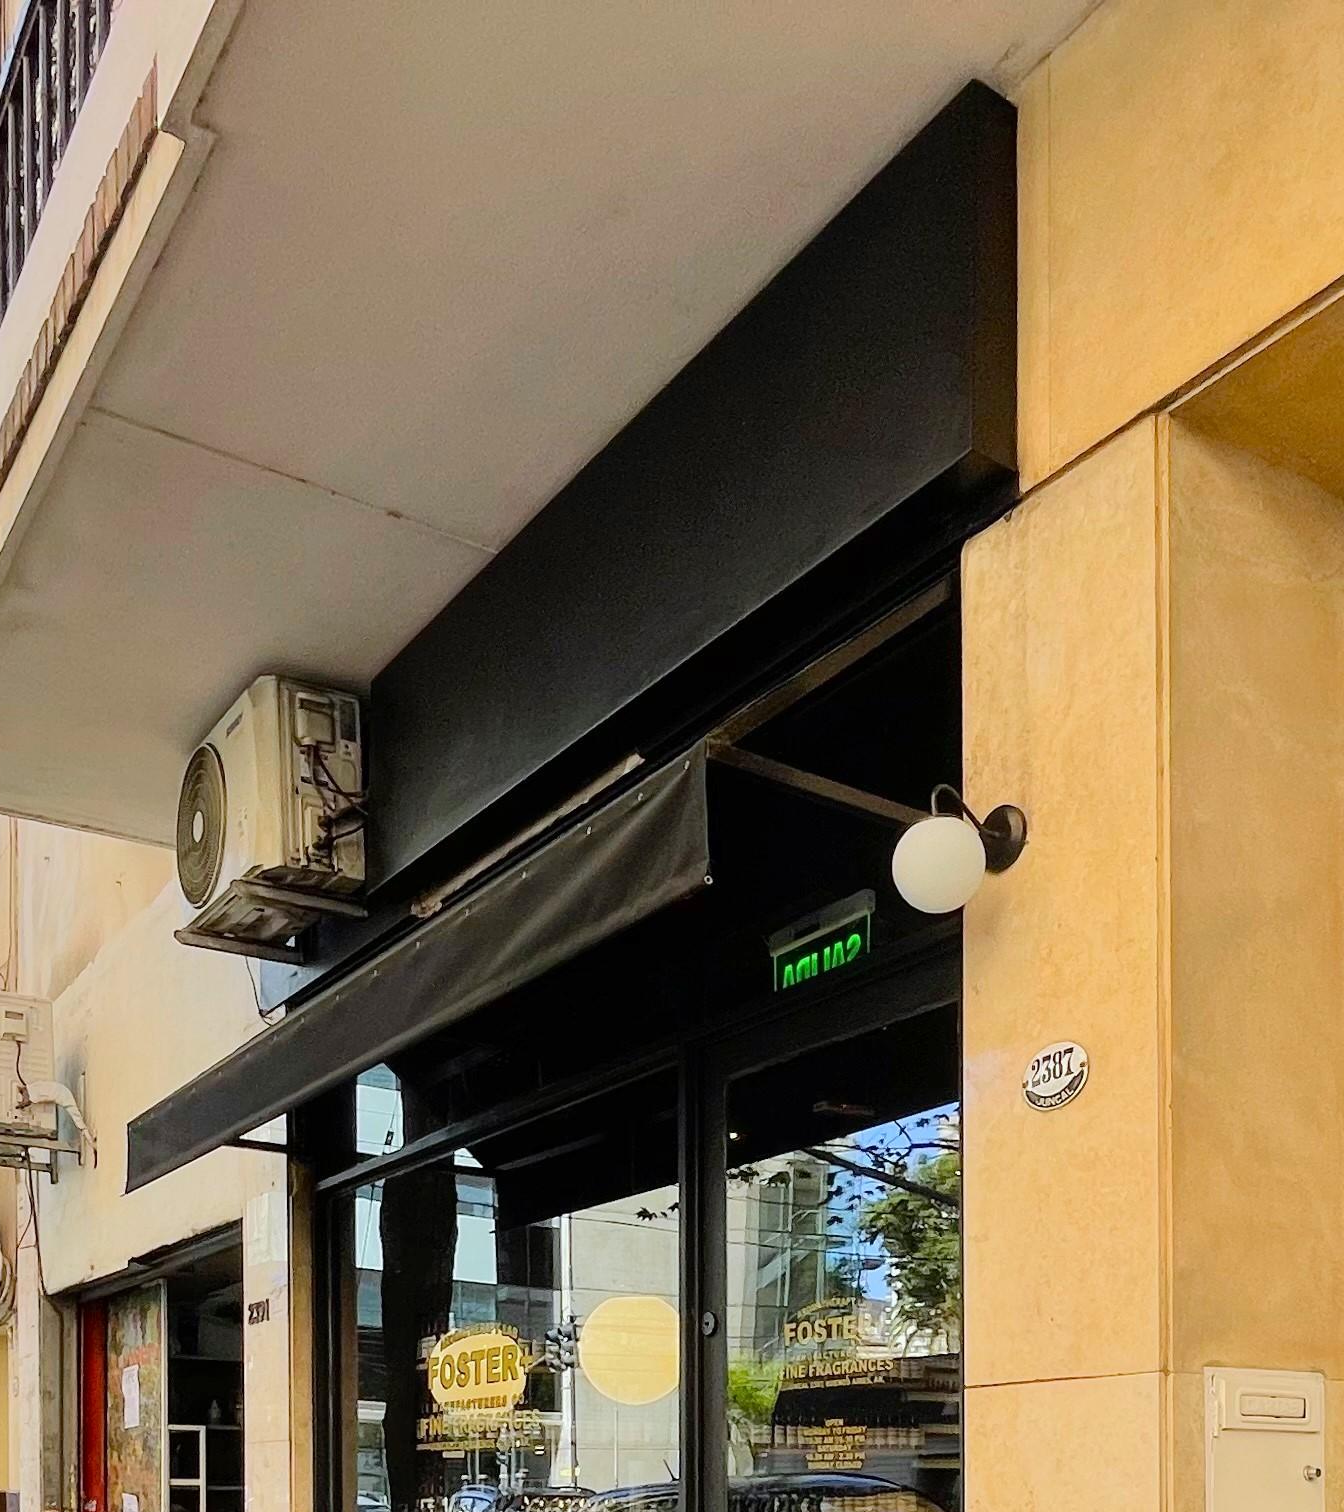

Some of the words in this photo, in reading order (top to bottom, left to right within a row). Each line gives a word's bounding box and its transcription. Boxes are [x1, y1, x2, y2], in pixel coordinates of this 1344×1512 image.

[1031, 1047, 1074, 1088] 2387
[1035, 1087, 1074, 1106] JUNCAL
[779, 1364, 806, 1380] FINE
[809, 1358, 894, 1378] FRAGRANCES
